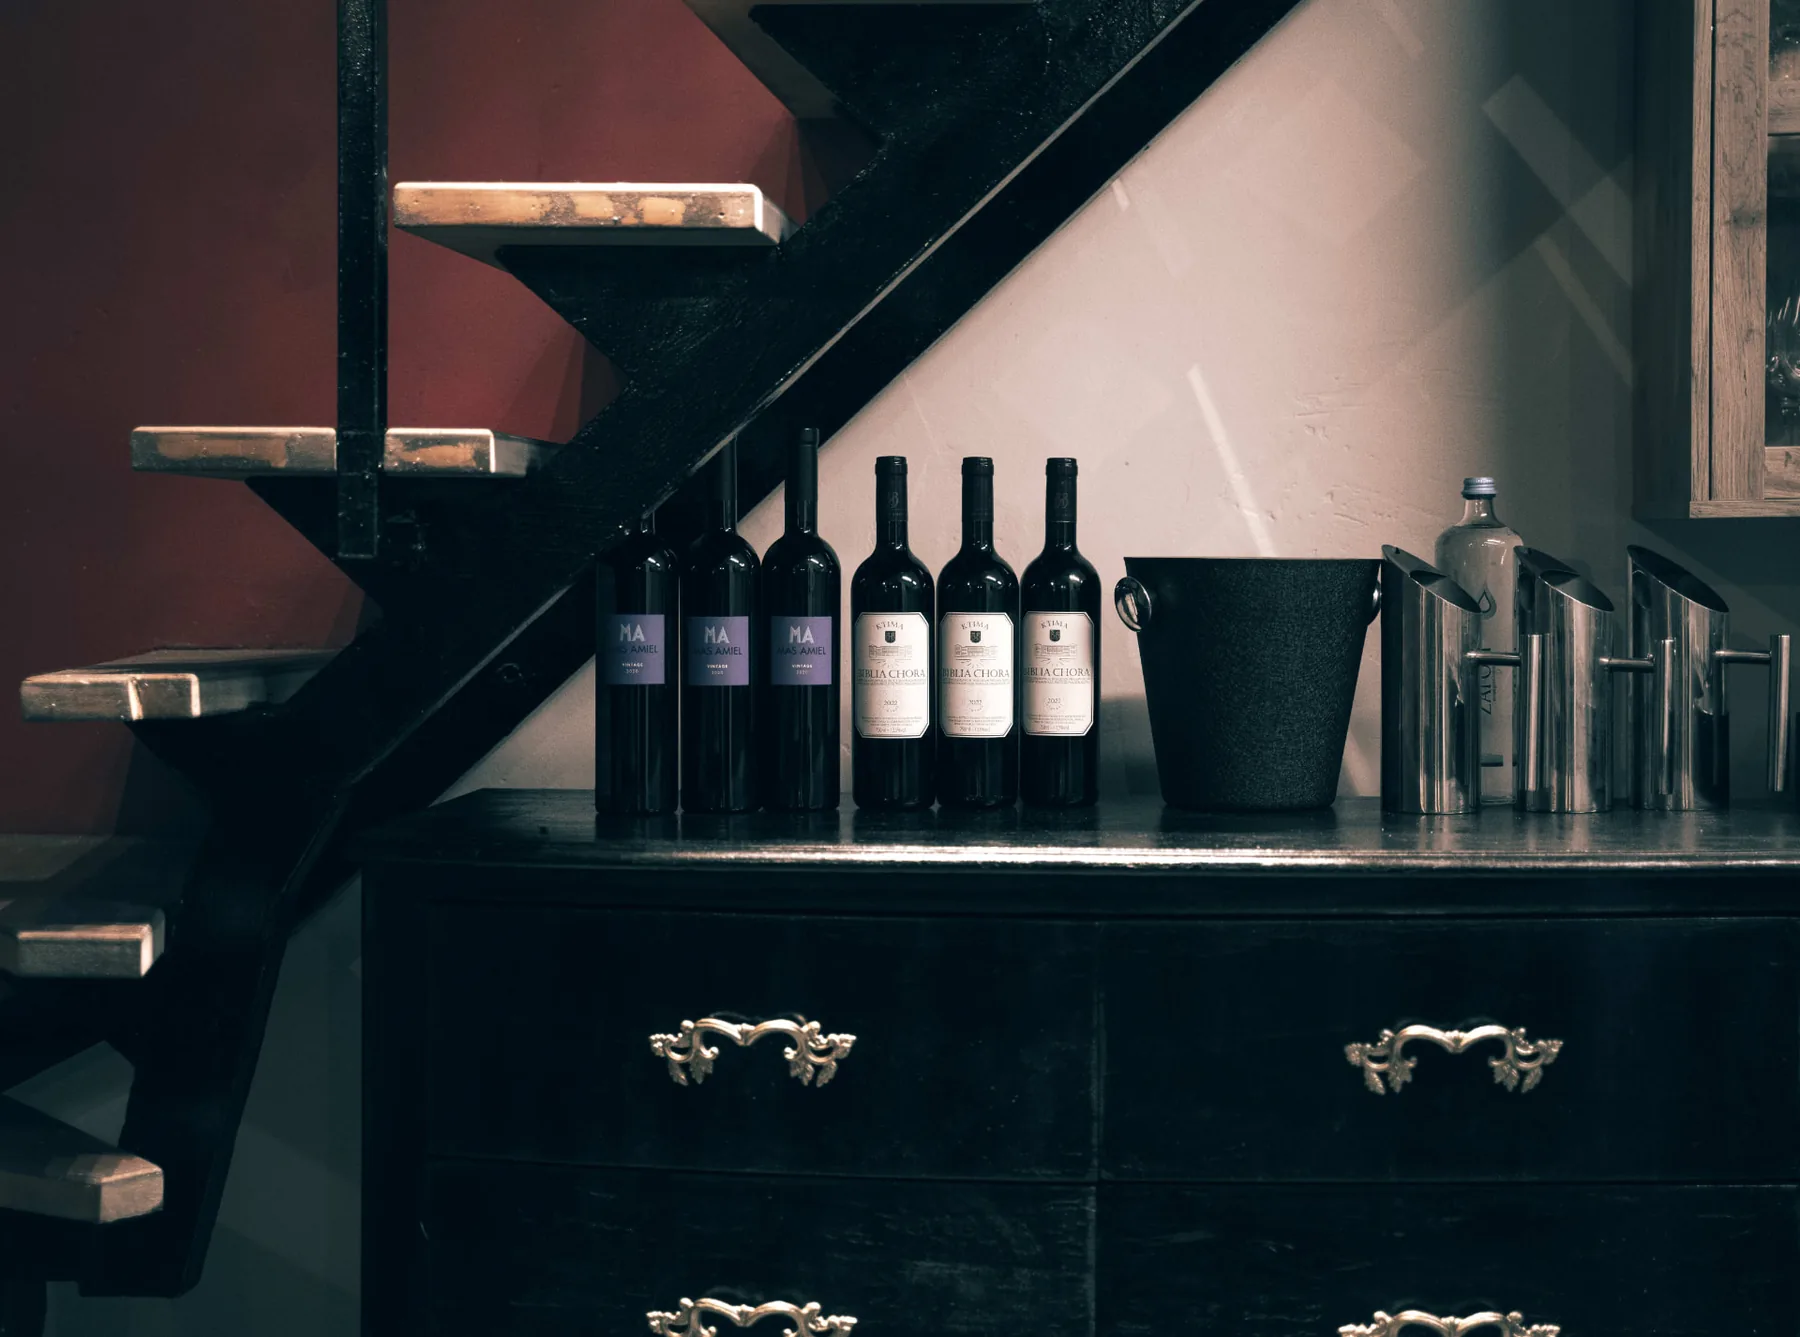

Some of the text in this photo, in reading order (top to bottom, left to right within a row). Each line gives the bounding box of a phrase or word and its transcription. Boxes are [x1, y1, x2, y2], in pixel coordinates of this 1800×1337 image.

[876, 620, 904, 630] KTIMA
[961, 621, 989, 630] KTIMA
[1041, 619, 1068, 629] KTIMA
[619, 623, 646, 642] MA
[704, 625, 730, 644] MA
[788, 625, 815, 644] MA
[630, 644, 659, 654] AMIEL
[714, 646, 743, 656] AMIEL
[775, 646, 827, 656] MAS AMIEL
[857, 668, 926, 679] BIBLIA CHORA
[942, 668, 1010, 678] BIBLIA CHORA
[1023, 667, 1090, 677] BIBLIA CHORA
